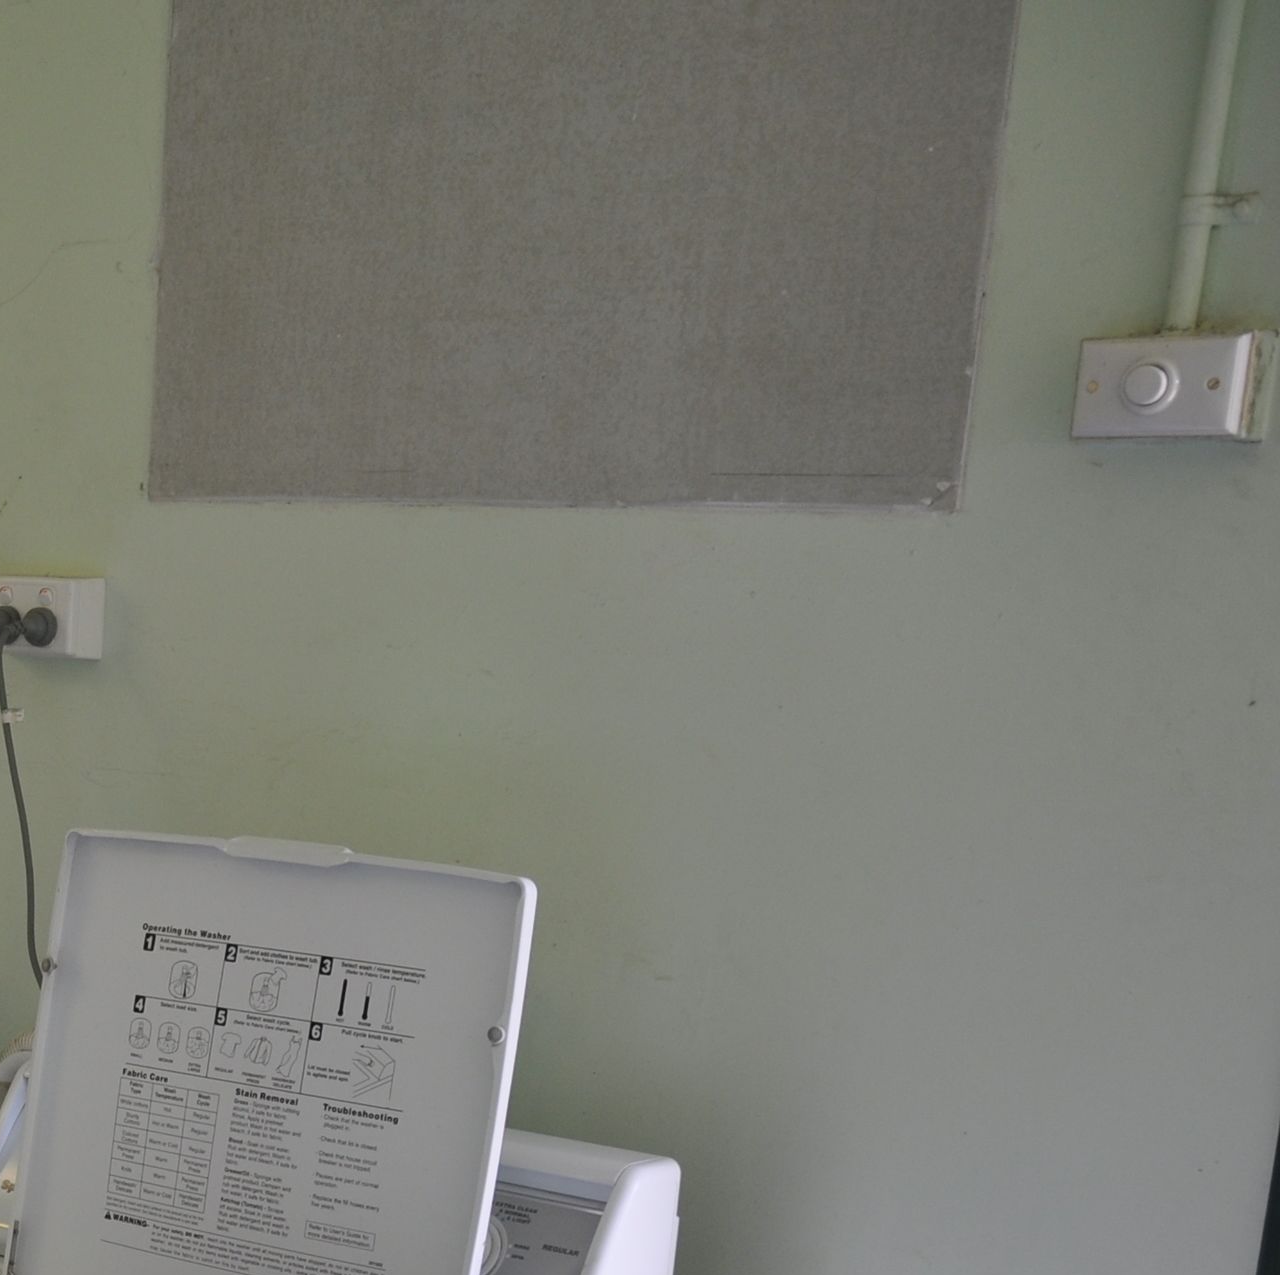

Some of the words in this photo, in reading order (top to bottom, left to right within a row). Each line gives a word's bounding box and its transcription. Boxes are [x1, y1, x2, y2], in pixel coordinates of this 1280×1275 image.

[142, 922, 182, 935] Operating
[184, 927, 197, 936] the
[199, 929, 231, 940] Washer
[121, 1067, 147, 1078] Fabric
[149, 1072, 168, 1082] Care
[235, 1087, 257, 1097] Stain
[259, 1092, 298, 1105] Removal
[322, 1103, 399, 1125] Troubleshooting
[542, 1243, 579, 1257] REGULAR
